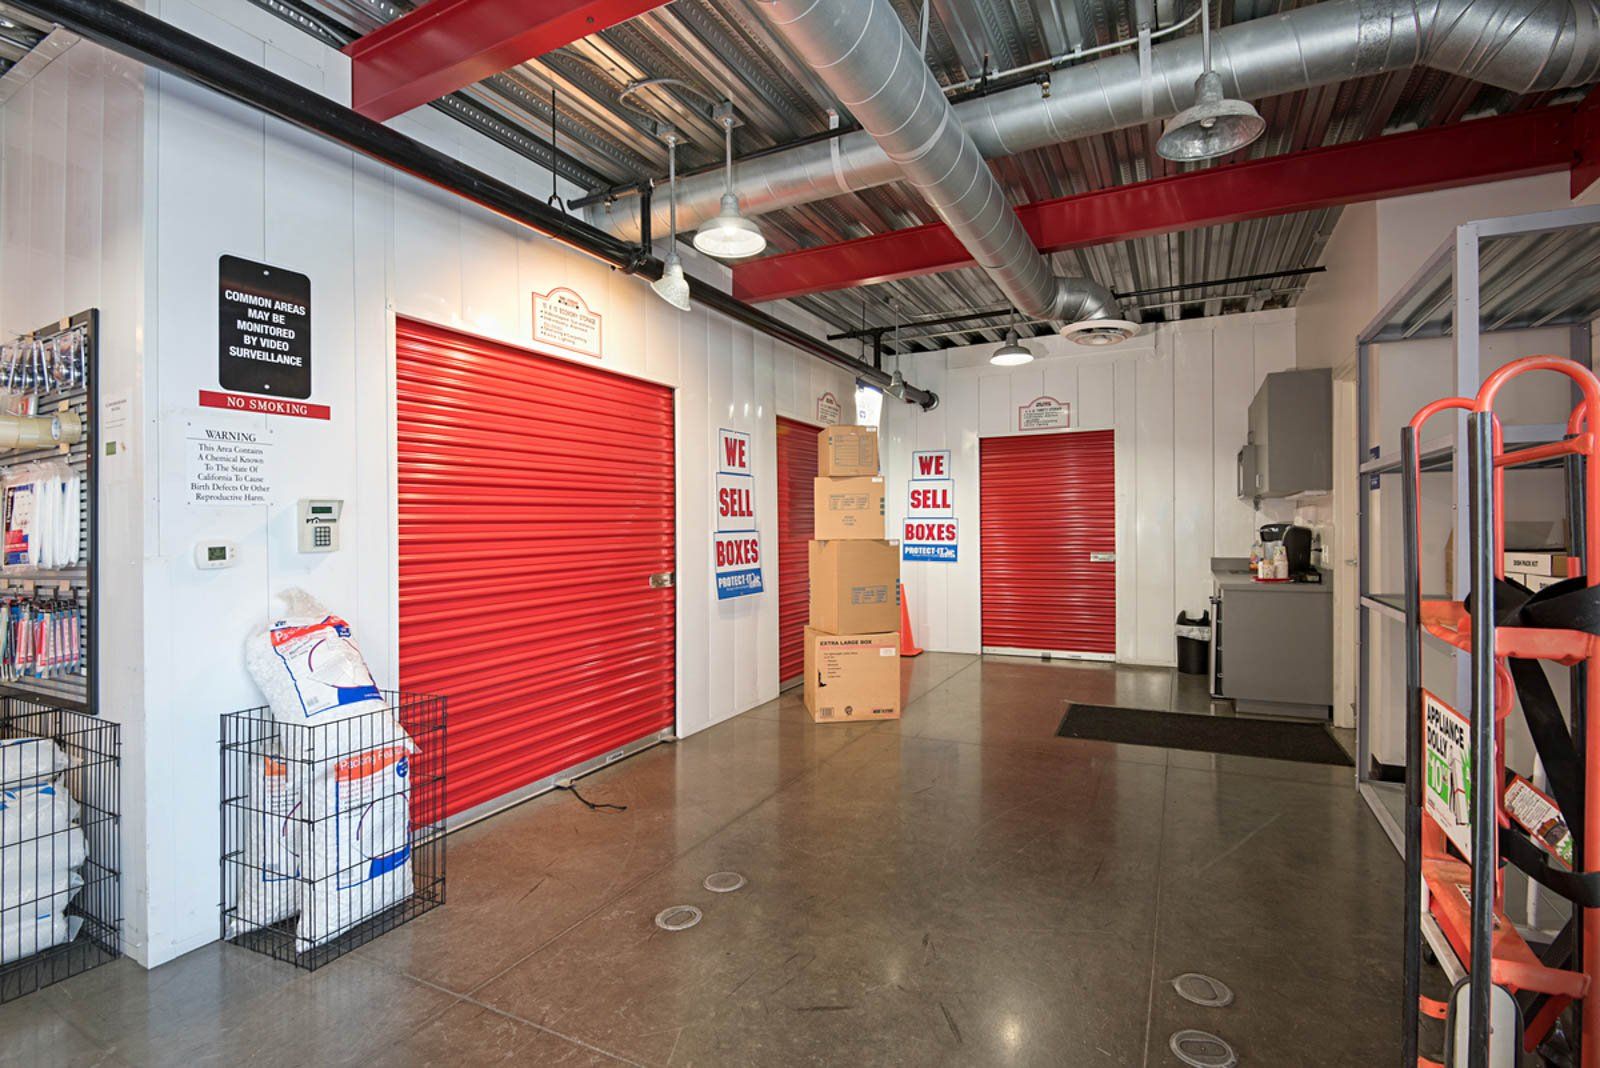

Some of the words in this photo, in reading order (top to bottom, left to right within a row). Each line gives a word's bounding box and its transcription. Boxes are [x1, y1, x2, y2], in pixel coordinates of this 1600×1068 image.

[225, 289, 272, 308] COMMON
[274, 301, 306, 316] AREAS
[247, 308, 270, 322] MAY
[272, 314, 286, 325] BE
[237, 320, 296, 339] MONITORED
[243, 334, 258, 346] BY
[259, 337, 289, 351] VIDEO
[229, 346, 302, 367] SURVEILLANCE
[227, 397, 245, 408] NO
[249, 400, 308, 415] SMOKING
[205, 429, 257, 442] WARNING
[198, 443, 214, 452] This
[216, 445, 232, 453] Area
[234, 446, 264, 455] Contains
[725, 437, 746, 468] WE
[204, 463, 213, 471] To
[215, 463, 229, 472] The
[231, 465, 248, 473] State
[249, 465, 259, 473] Of
[205, 454, 238, 463] Chemical
[239, 456, 264, 464] Known
[919, 455, 944, 475] WE
[191, 482, 210, 490] Birth
[212, 483, 238, 491] Defects
[250, 484, 270, 492] Other
[197, 473, 233, 481] California
[234, 474, 243, 482] To
[244, 475, 264, 483] Cause
[195, 492, 242, 502] Reproductive
[719, 488, 753, 517] SELL
[911, 489, 951, 509] SELL
[905, 524, 956, 541] BOXES
[716, 539, 759, 567] BOXES
[1427, 703, 1465, 750] APPLIANCE
[1427, 725, 1448, 759] DOLLY
